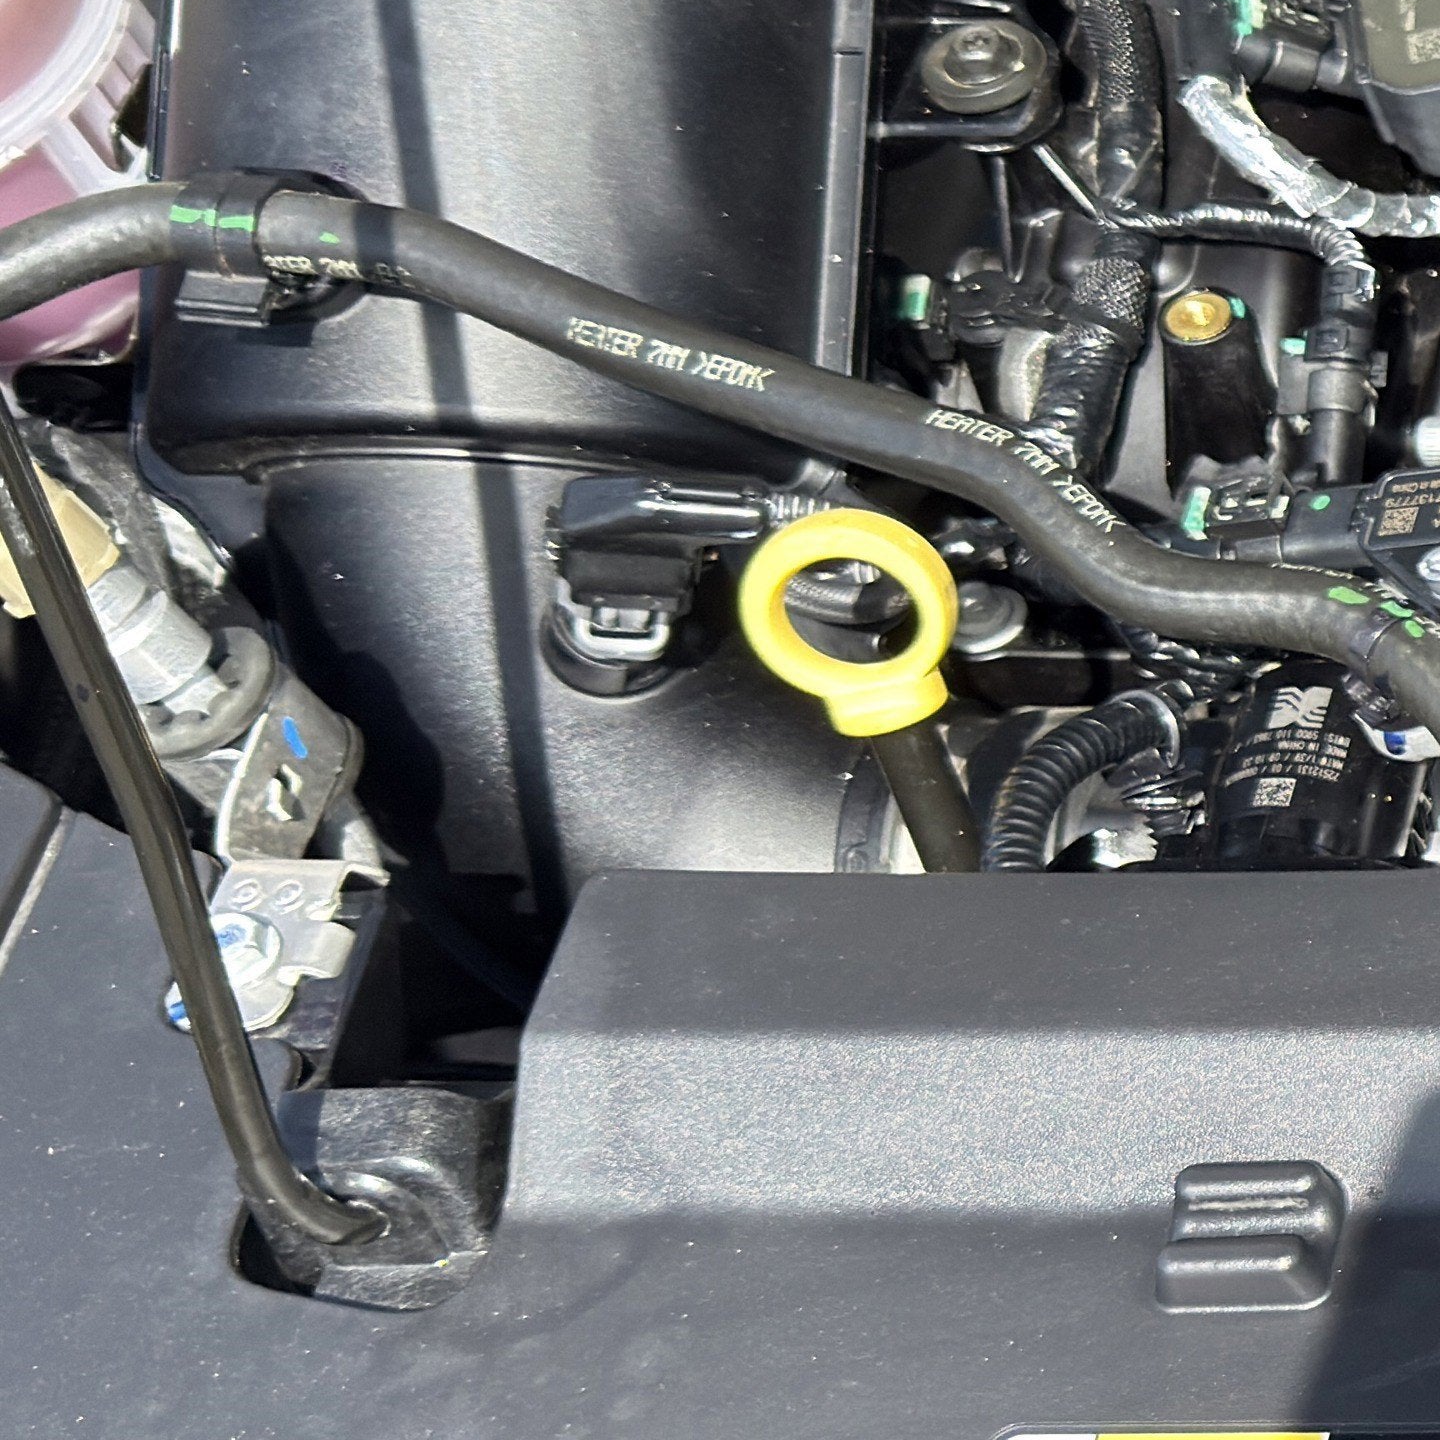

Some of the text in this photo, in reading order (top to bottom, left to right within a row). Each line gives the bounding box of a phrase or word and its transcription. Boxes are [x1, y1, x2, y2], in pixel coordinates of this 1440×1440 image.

[566, 317, 643, 359] HEATER
[925, 409, 1015, 447] HEATER
[1014, 441, 1062, 475] 7MM
